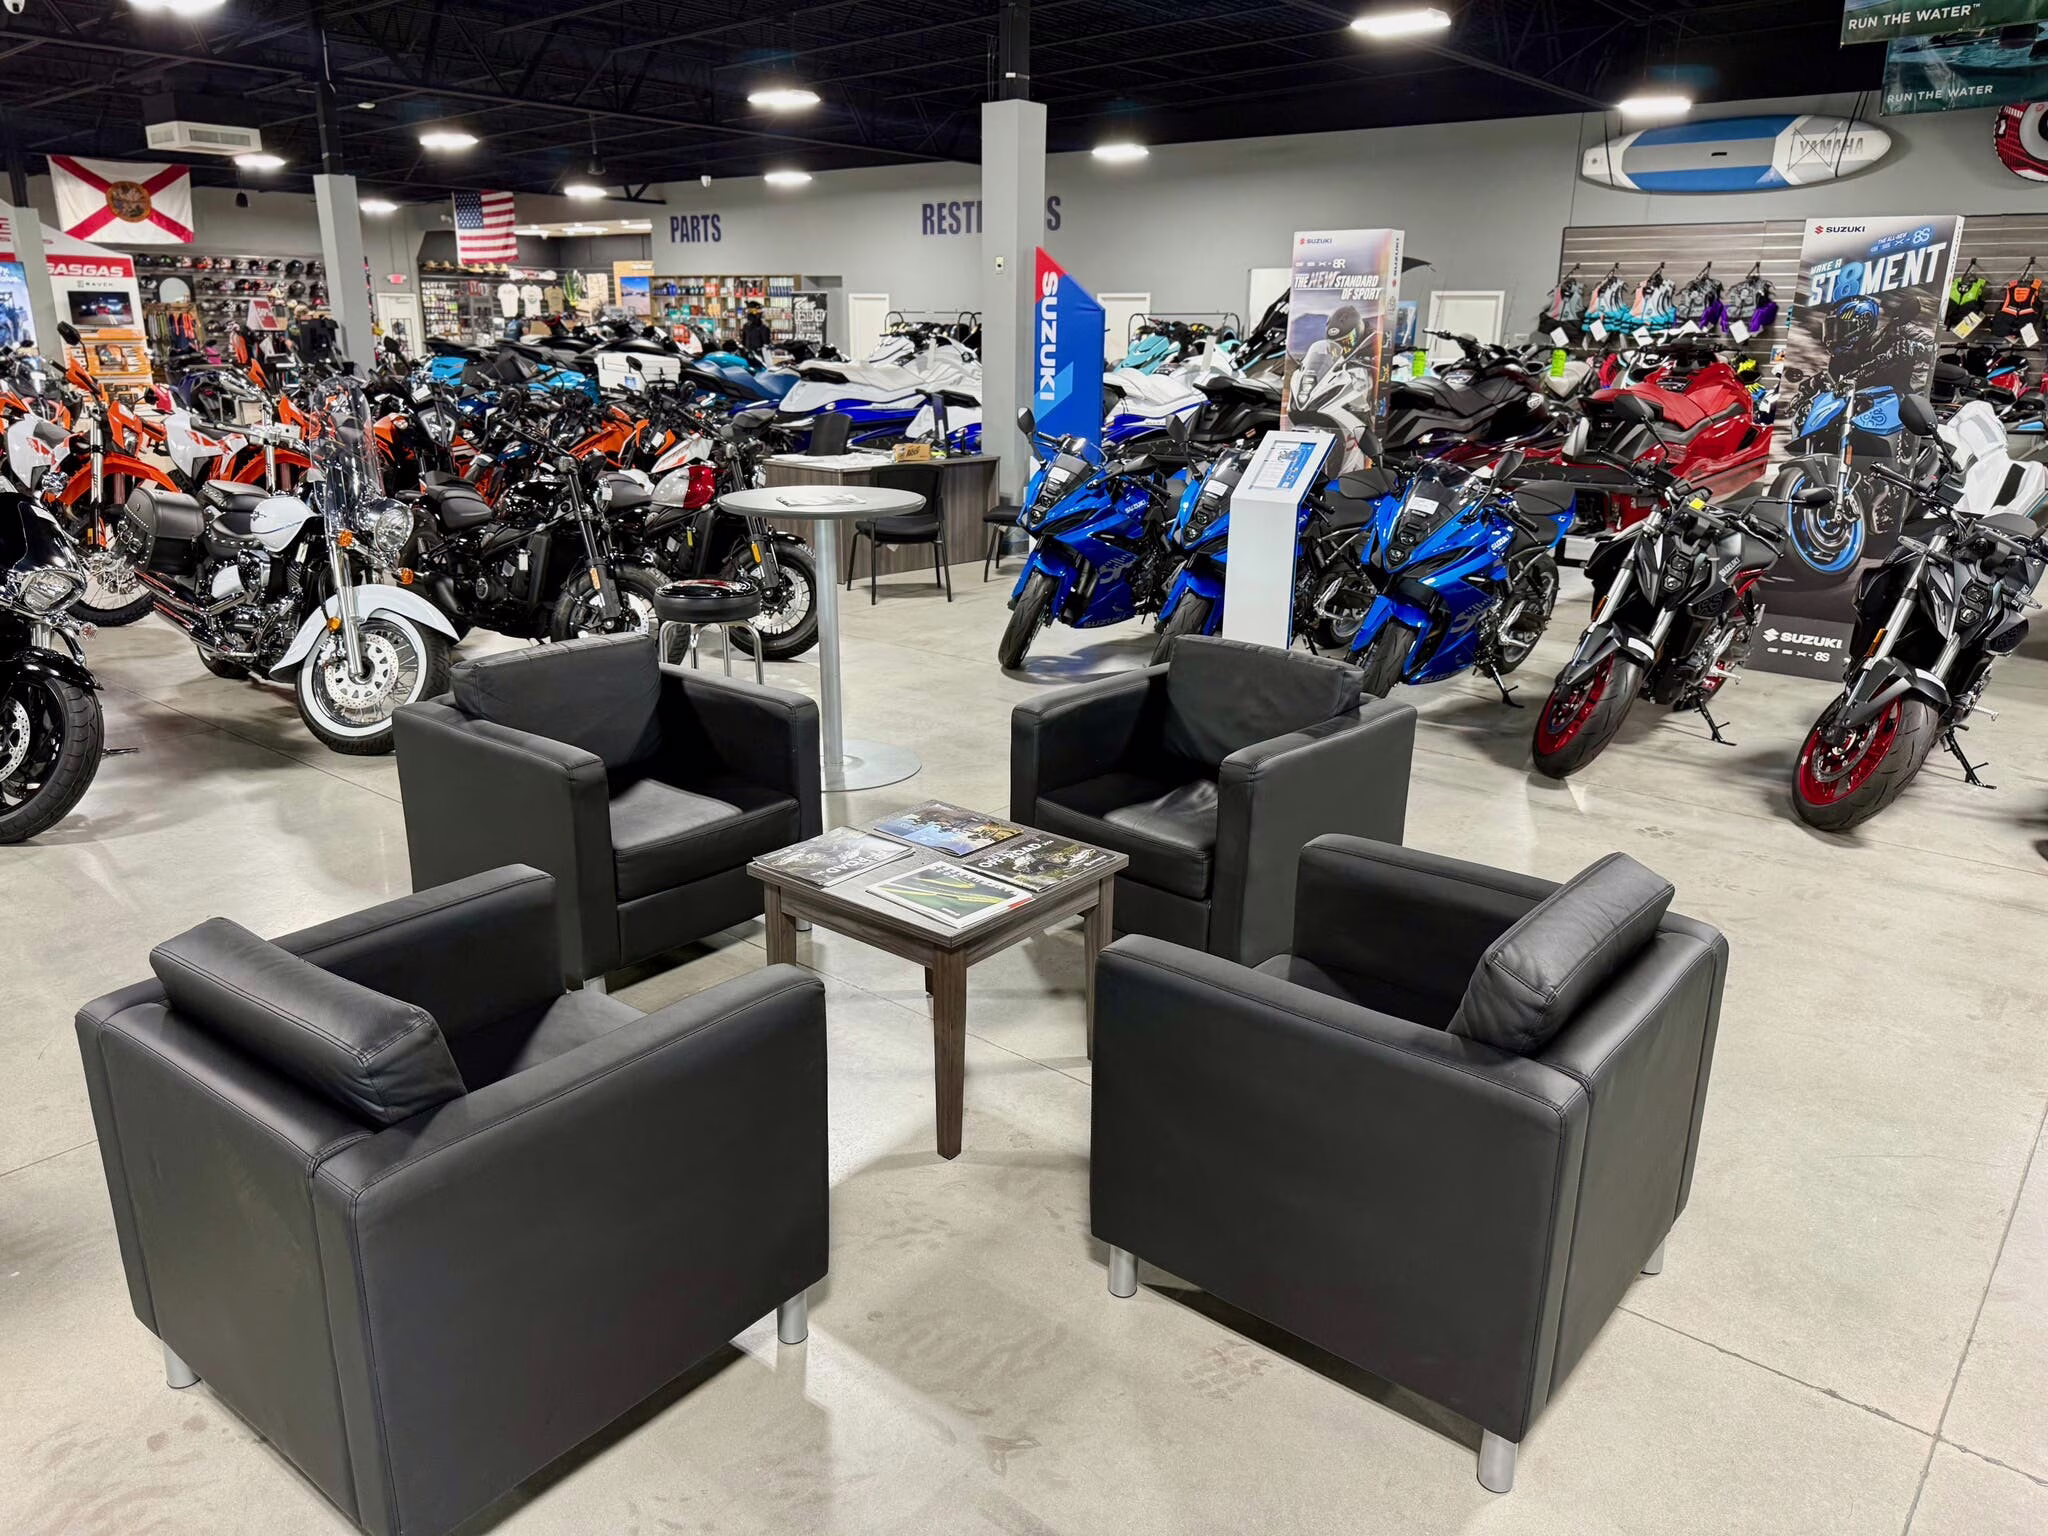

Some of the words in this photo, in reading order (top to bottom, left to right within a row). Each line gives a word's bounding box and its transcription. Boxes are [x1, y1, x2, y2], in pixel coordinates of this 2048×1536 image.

[1848, 15, 1878, 30] RUN
[1883, 12, 1911, 25] THE
[1887, 92, 1912, 103] RUN
[1918, 89, 1942, 100] THE
[1948, 84, 1993, 98] WATER
[1799, 137, 1864, 155] YAMAHA
[922, 196, 1061, 235] RESTS
[670, 214, 721, 243] PARTS
[1825, 225, 1866, 233] SUZUKI
[1808, 242, 1947, 307] ST8MENT
[1810, 260, 1834, 275] MAKE
[1835, 258, 1843, 269] A
[1294, 275, 1310, 288] THE
[1308, 271, 1338, 289] NEW
[1334, 275, 1380, 288] STANDARD
[1341, 288, 1354, 300] OF
[1352, 287, 1382, 300] SPORT
[1040, 271, 1059, 400] SUZUKI
[1779, 632, 1843, 649] SUZUKI
